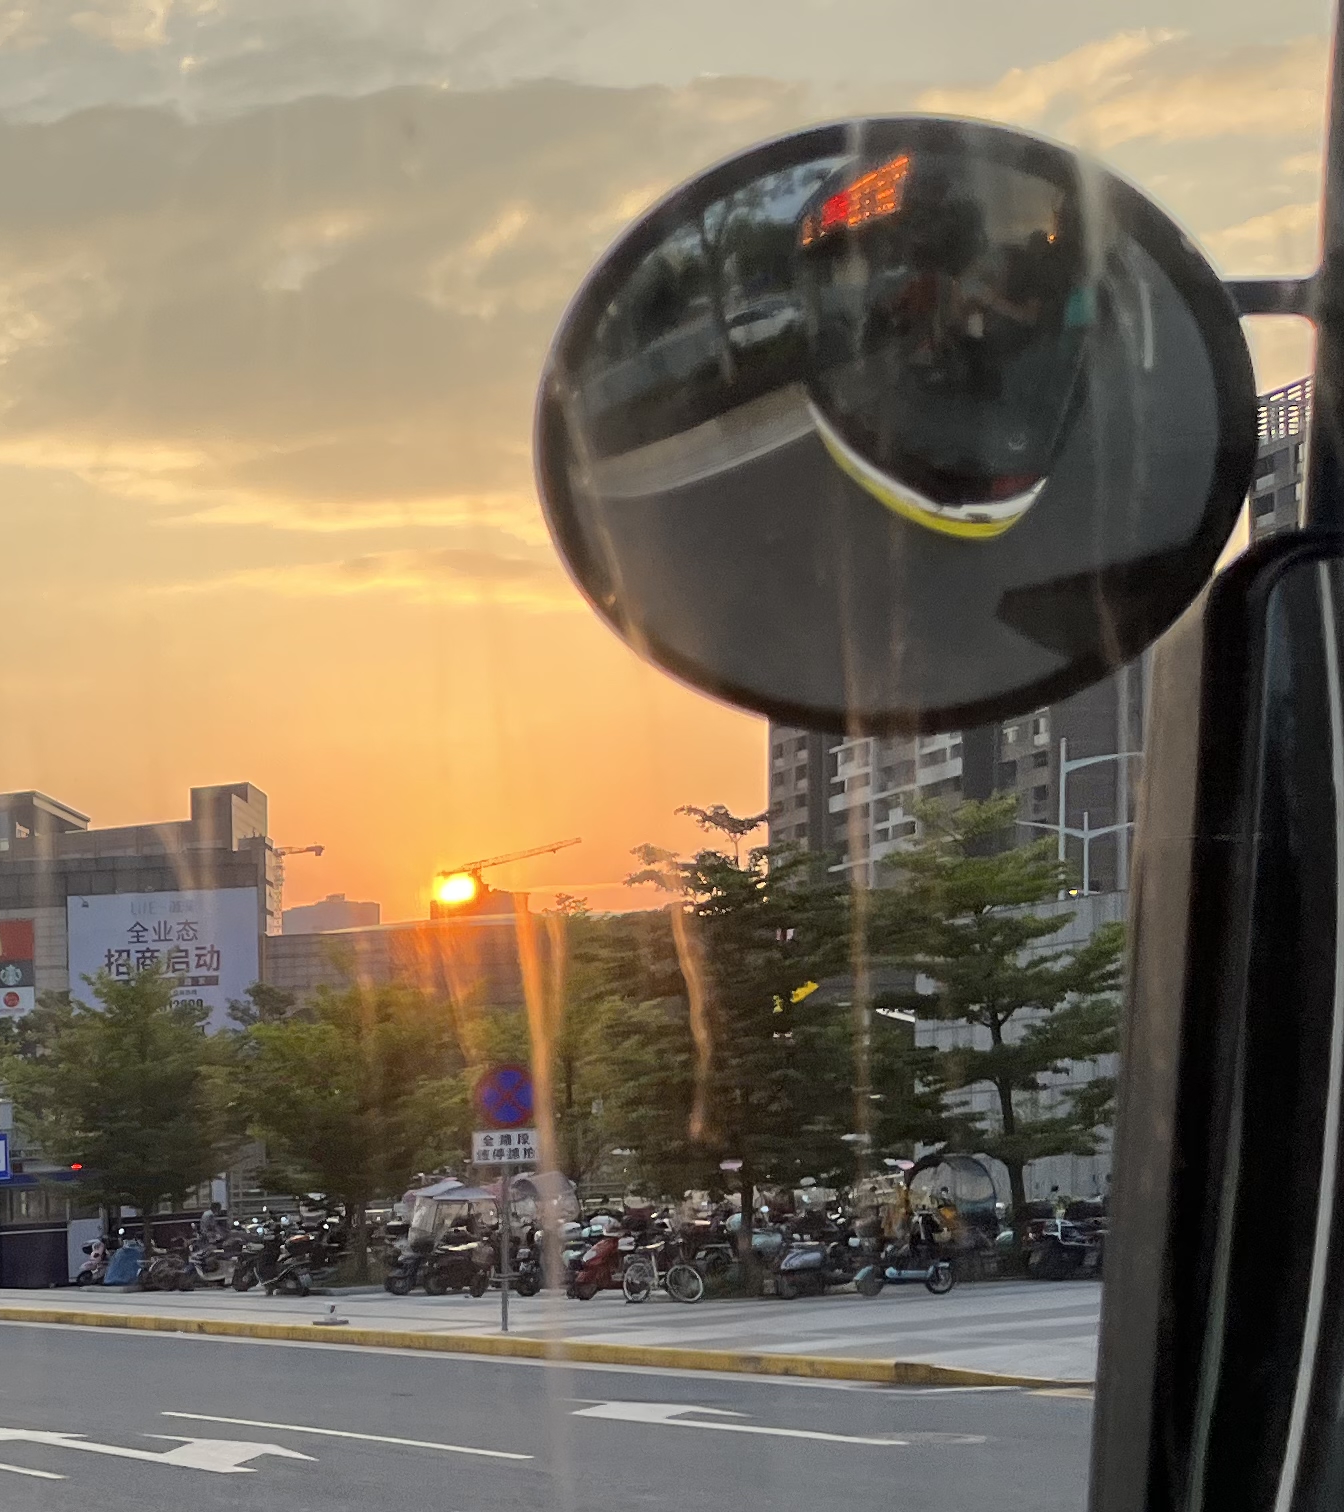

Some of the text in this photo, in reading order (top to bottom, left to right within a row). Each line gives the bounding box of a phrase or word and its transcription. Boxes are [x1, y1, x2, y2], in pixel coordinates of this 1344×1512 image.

[127, 919, 199, 945] 全业态
[105, 943, 221, 977] 招商启动
